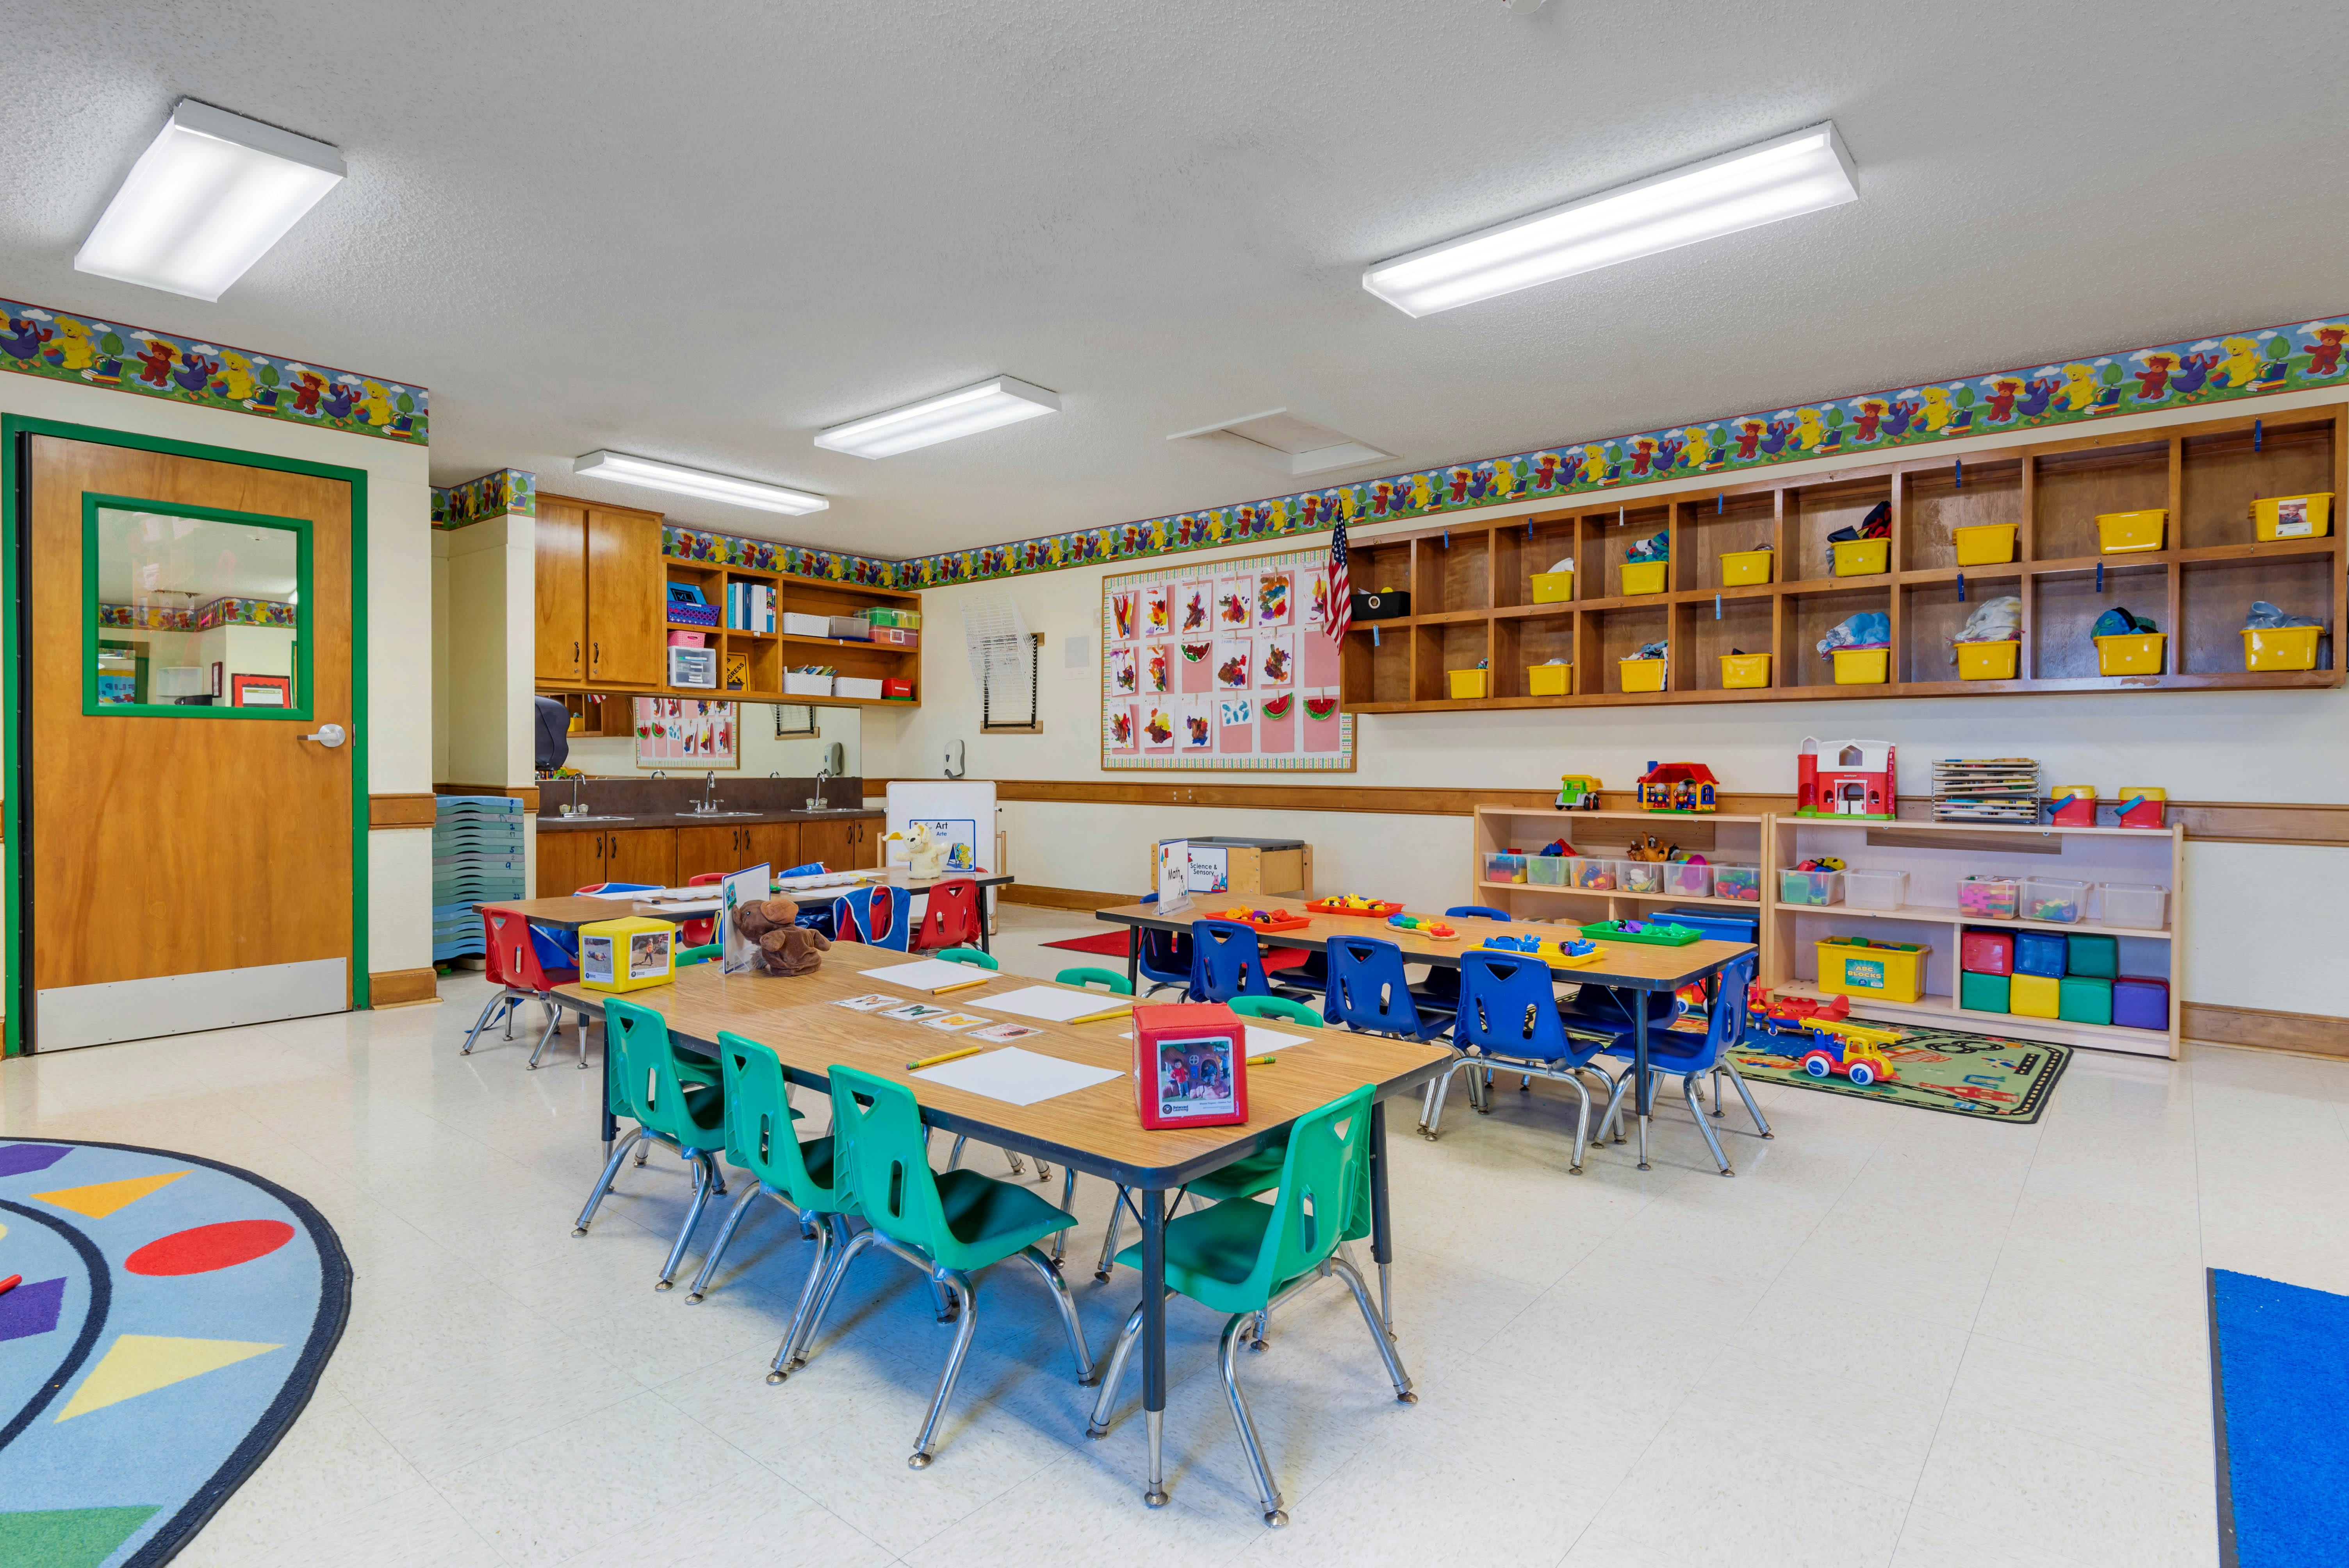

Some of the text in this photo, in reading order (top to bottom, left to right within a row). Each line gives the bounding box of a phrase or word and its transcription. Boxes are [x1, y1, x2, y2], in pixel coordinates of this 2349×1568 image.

[677, 593, 694, 602] XL
[1168, 867, 1180, 880] Math
[1847, 970, 1882, 979] BLOCKS
